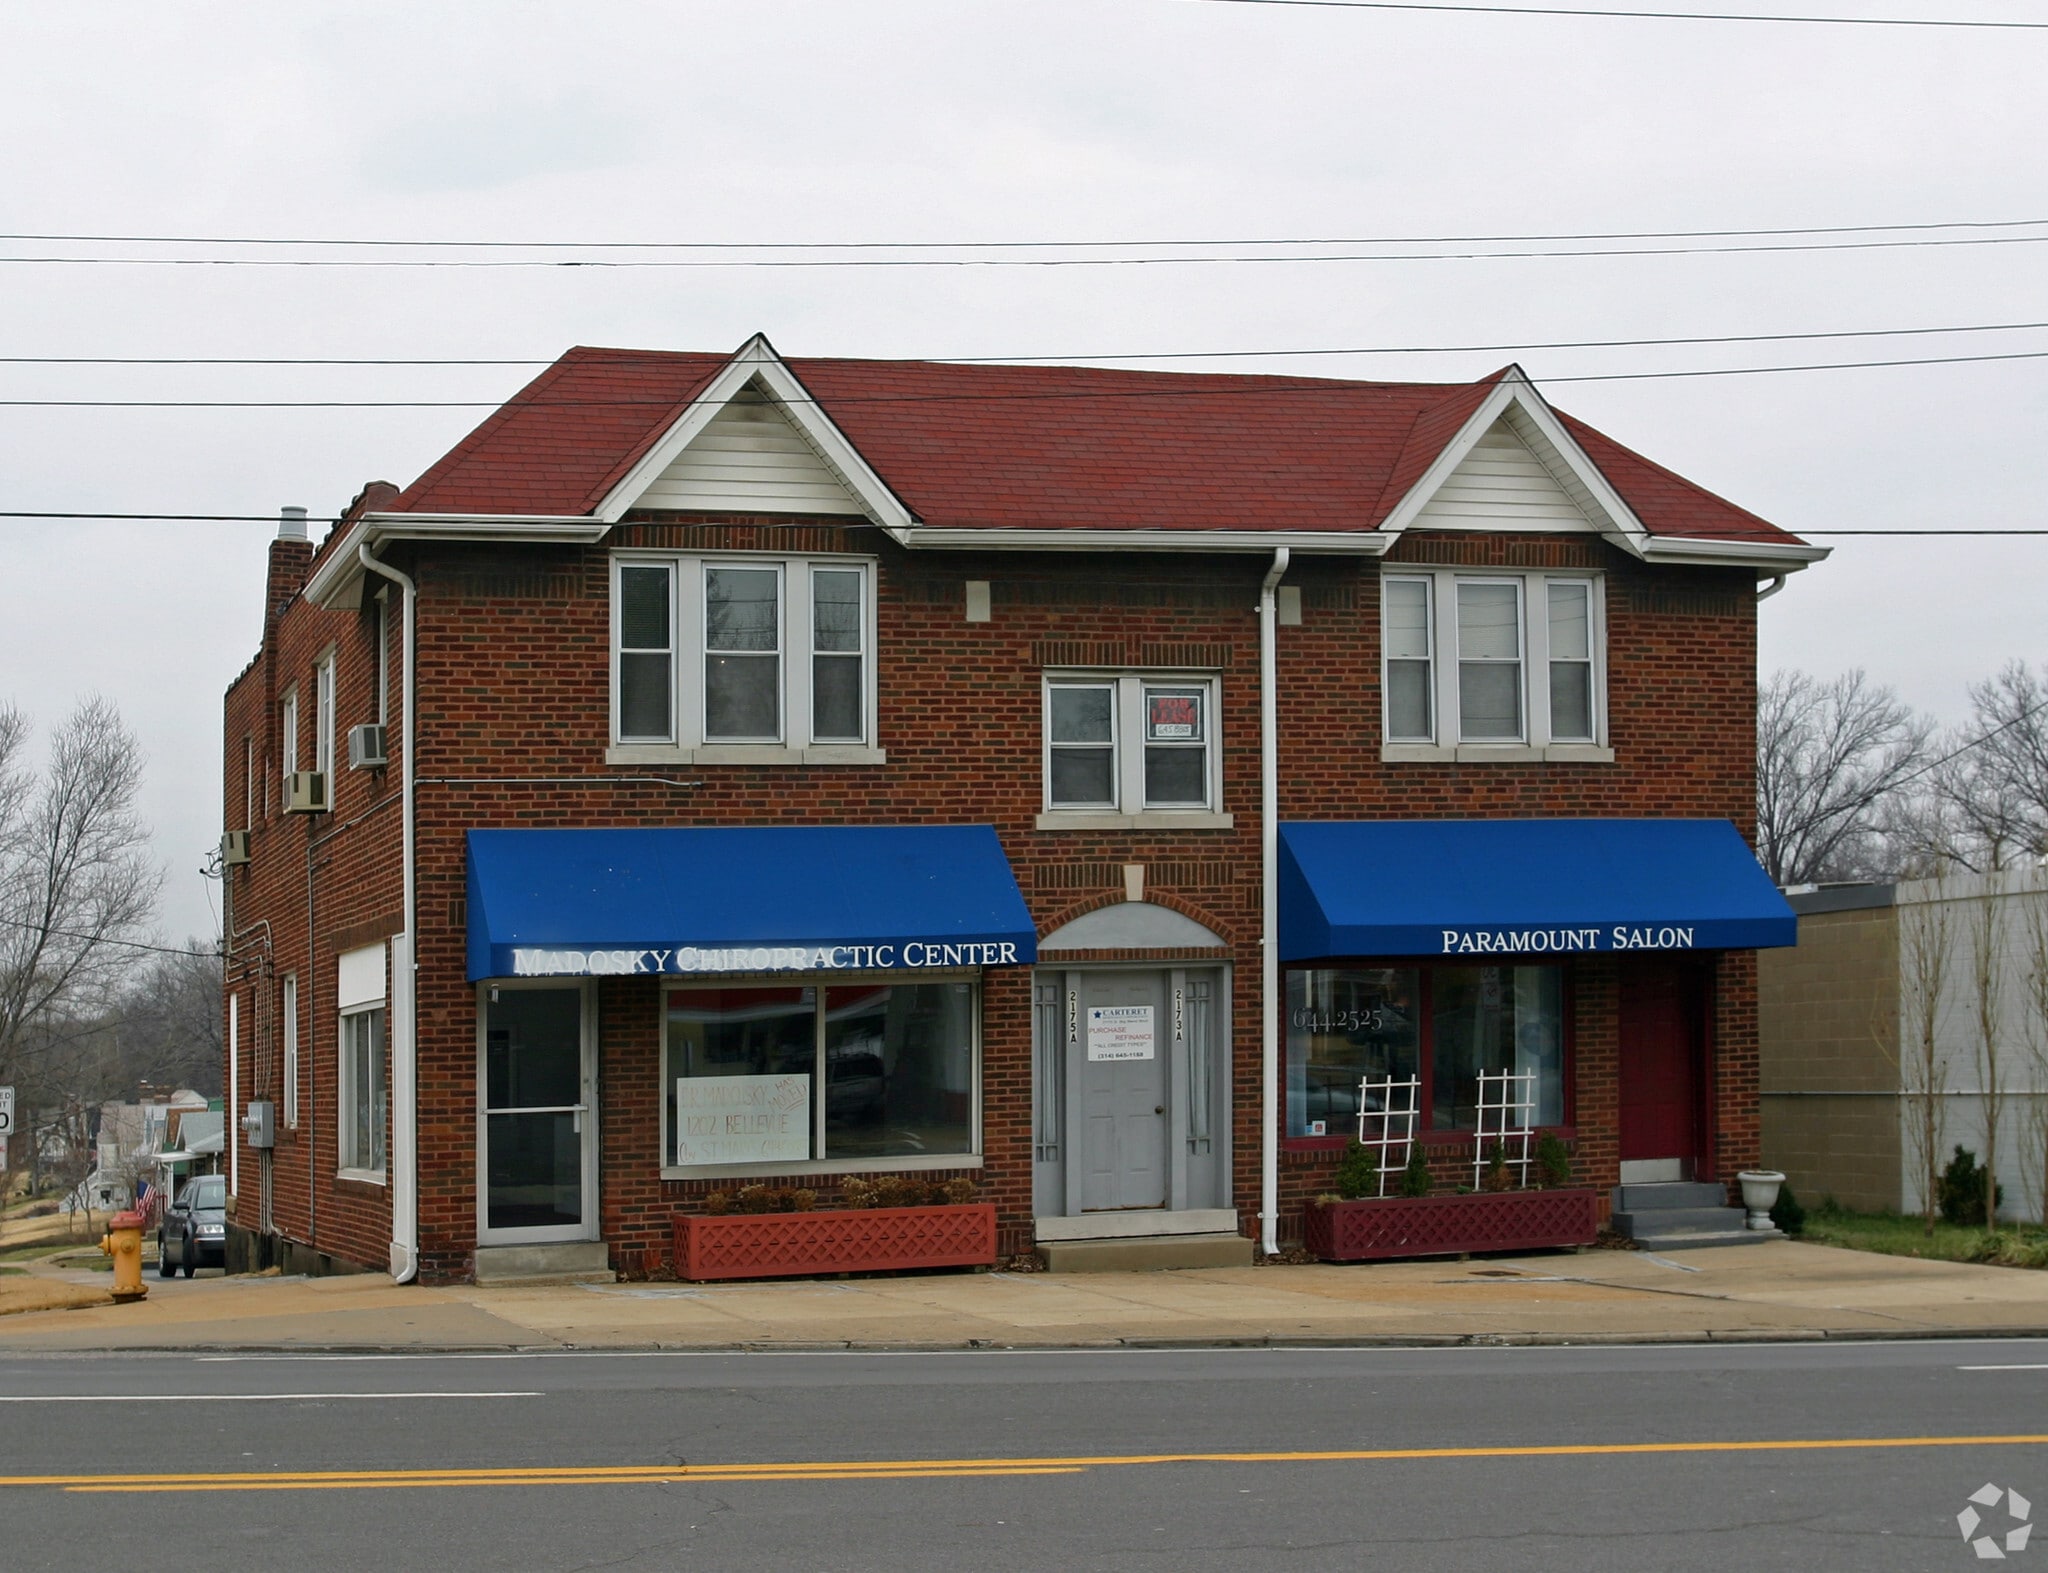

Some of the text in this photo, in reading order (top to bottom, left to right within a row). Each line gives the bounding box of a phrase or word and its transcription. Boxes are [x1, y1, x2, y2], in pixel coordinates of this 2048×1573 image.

[1442, 926, 1694, 953] PARAMOUNT SALON
[514, 941, 1018, 973] MADOSKY CHIROPRACTIC CENTER
[1103, 1008, 1148, 1016] CARTERET
[1293, 1007, 1383, 1033] 644.2525
